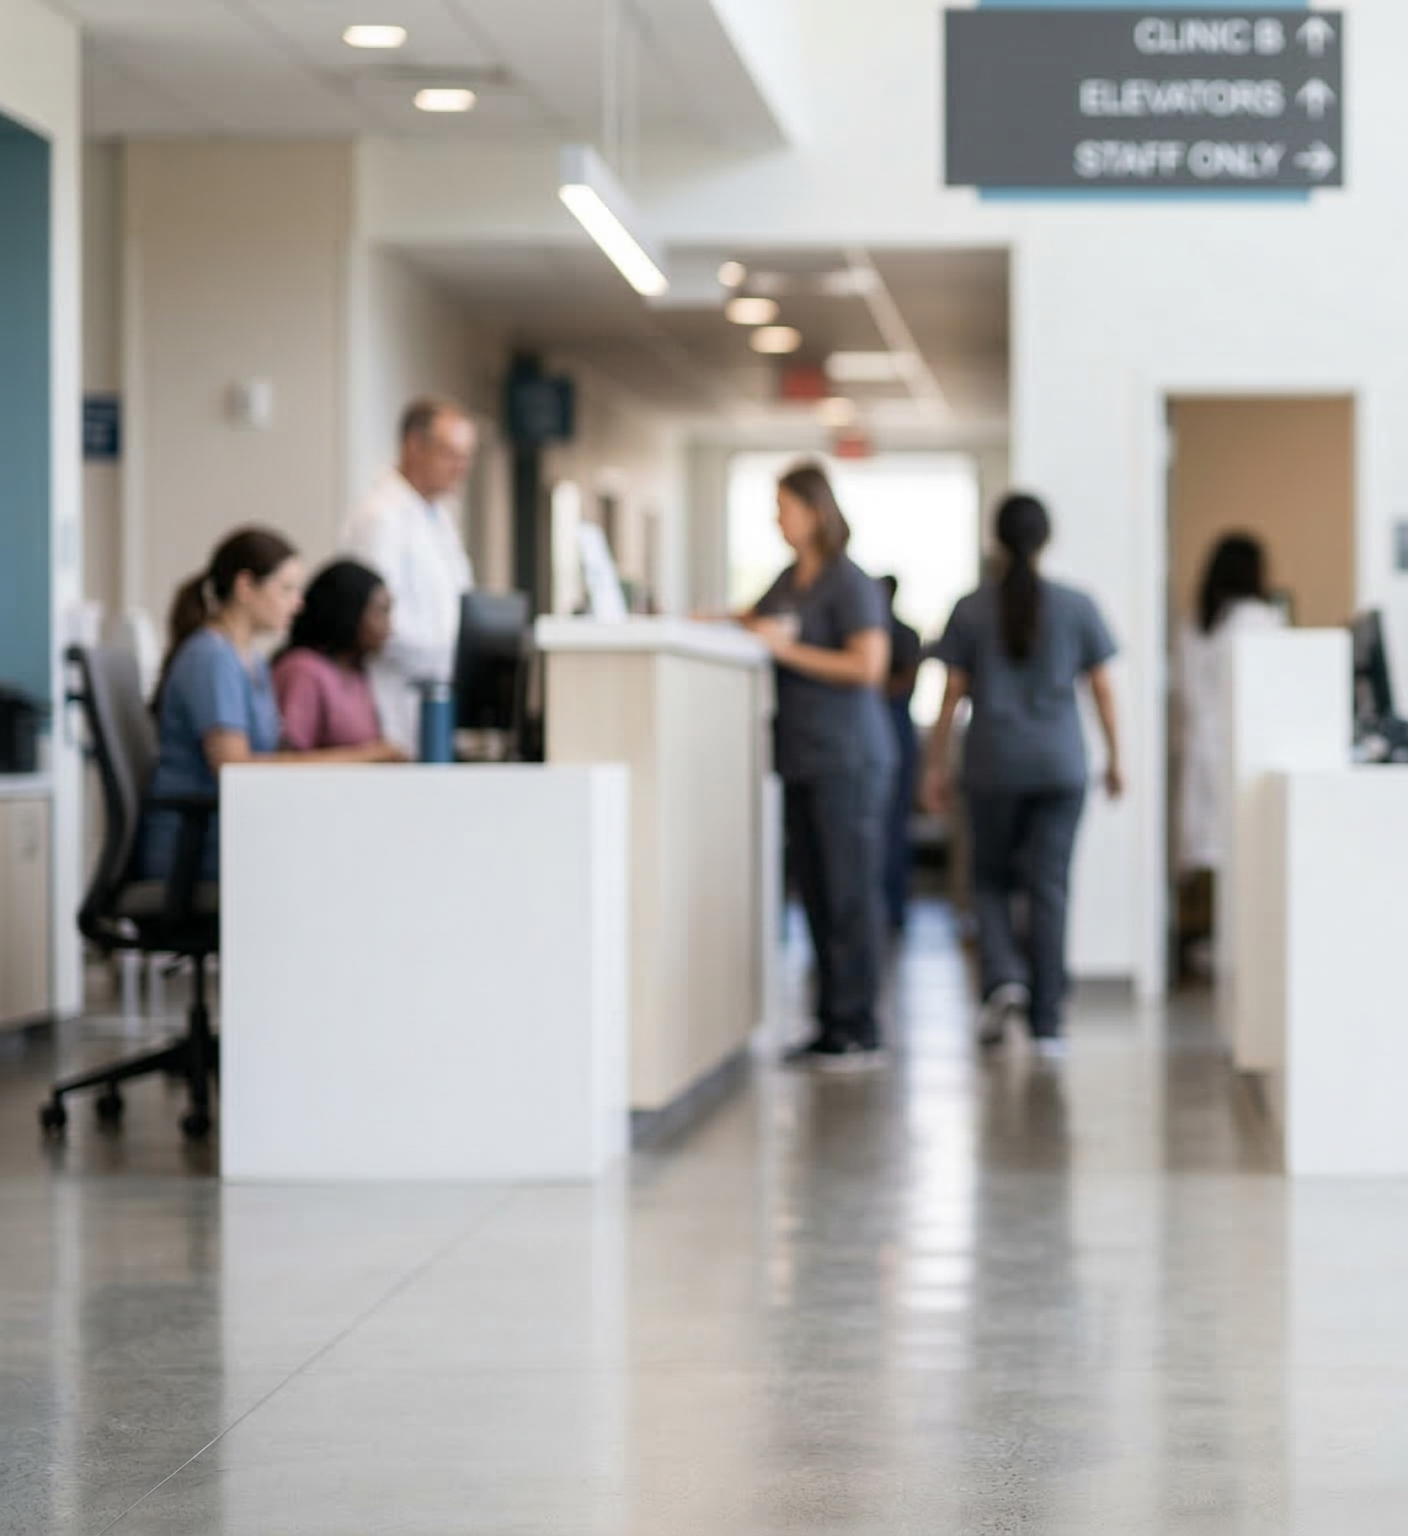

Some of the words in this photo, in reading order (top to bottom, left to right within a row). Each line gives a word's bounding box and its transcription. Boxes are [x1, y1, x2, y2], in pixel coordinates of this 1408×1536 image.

[1135, 17, 1252, 55] CLINIC
[1254, 17, 1286, 54] B
[1079, 79, 1285, 117] ELEVATORS
[1074, 140, 1186, 178] STAFF
[1188, 140, 1286, 178] ONLY
